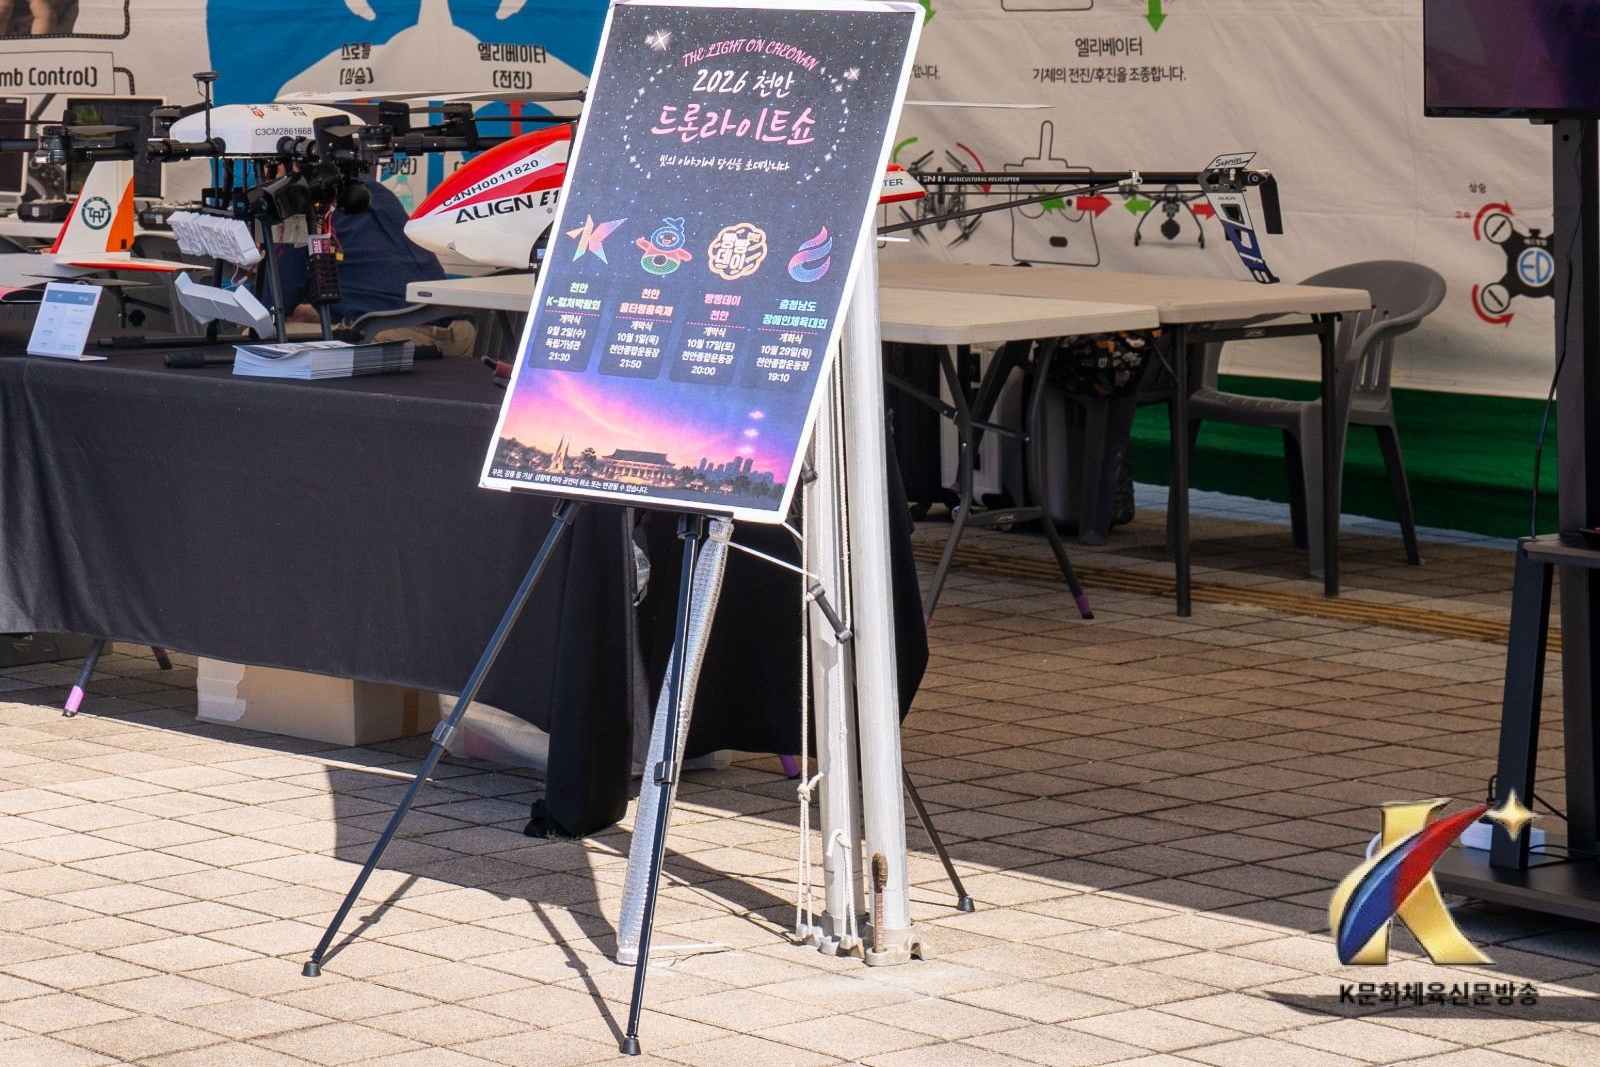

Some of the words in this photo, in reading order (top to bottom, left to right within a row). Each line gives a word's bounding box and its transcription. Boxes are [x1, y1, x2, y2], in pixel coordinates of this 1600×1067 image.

[341, 43, 371, 61] 스로틀
[477, 42, 547, 64] 엘리베이터
[1075, 37, 1143, 57] 엘리베이터
[683, 47, 704, 67] THE
[706, 39, 746, 58] LIGHT
[745, 39, 765, 52] ON
[766, 41, 820, 71] CHEONAN
[28, 66, 97, 88] Control)
[340, 68, 374, 85] (상승)
[493, 70, 532, 89] (전진)
[1033, 68, 1066, 83] 기체의
[1069, 66, 1127, 83] 전진/후진을
[1129, 66, 1187, 82] 조종합니다.
[692, 69, 749, 93] 2026
[752, 70, 795, 98] 천안
[651, 103, 816, 145] 드론라이트쇼
[717, 158, 742, 171] 당신을
[744, 160, 790, 173] 초대합니다
[442, 159, 539, 208] C4NH0011820
[455, 195, 533, 224] ALIGN
[570, 283, 588, 293] 천안
[641, 288, 660, 299] 천안
[559, 314, 582, 325] 개막식
[710, 310, 729, 321] 천안
[762, 314, 828, 329] 장애인체육대회
[547, 326, 560, 336] 9월
[560, 327, 586, 339] 2일(수)
[630, 321, 653, 331] 개막식
[703, 327, 726, 337] 개막식
[546, 339, 581, 351] 독립기념관
[617, 332, 634, 343] 10월
[635, 334, 659, 345] 1일(목)
[687, 339, 704, 349] 10월
[705, 340, 735, 352] 17일(토)
[761, 345, 778, 355] 10월
[548, 352, 570, 362] 21:30
[619, 359, 642, 369] 21:50
[691, 366, 716, 375] 20:00
[768, 372, 790, 382] 19:10
